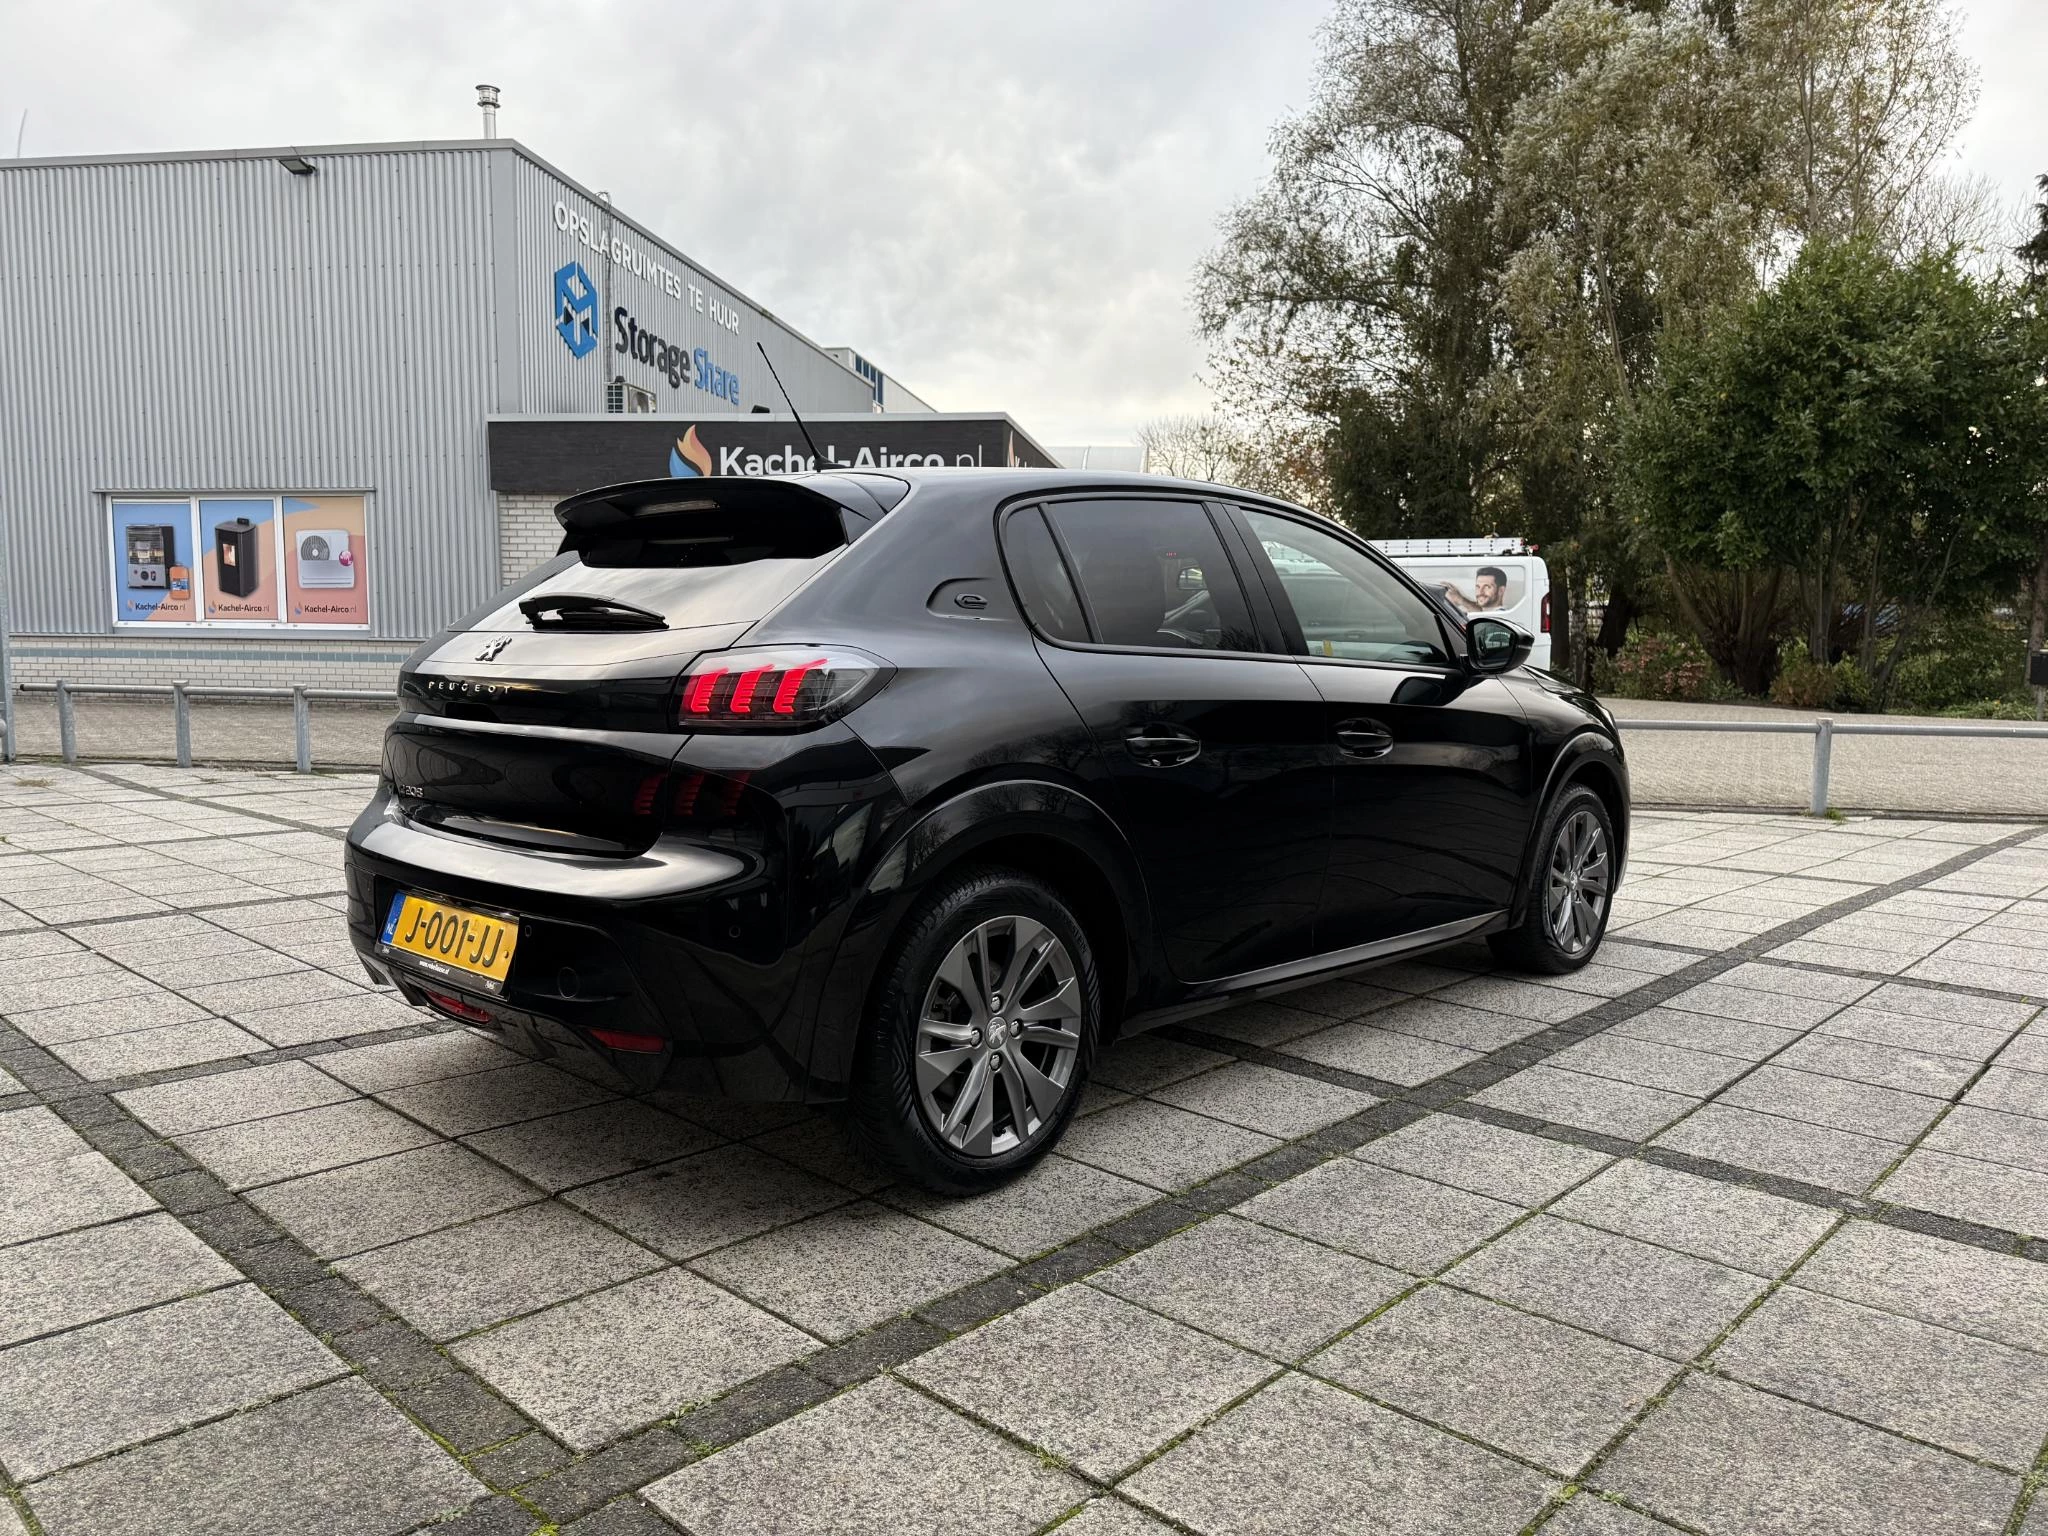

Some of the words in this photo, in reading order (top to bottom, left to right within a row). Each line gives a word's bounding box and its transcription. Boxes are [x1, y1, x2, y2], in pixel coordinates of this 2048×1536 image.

[554, 201, 681, 300] OPSLAGRUIMTES
[688, 283, 703, 313] TE
[709, 296, 739, 335] HUUR
[614, 306, 691, 389] Storage
[693, 347, 740, 405] Share
[428, 681, 512, 694] PEUGEOT
[405, 907, 504, 968] J-001-JJ
